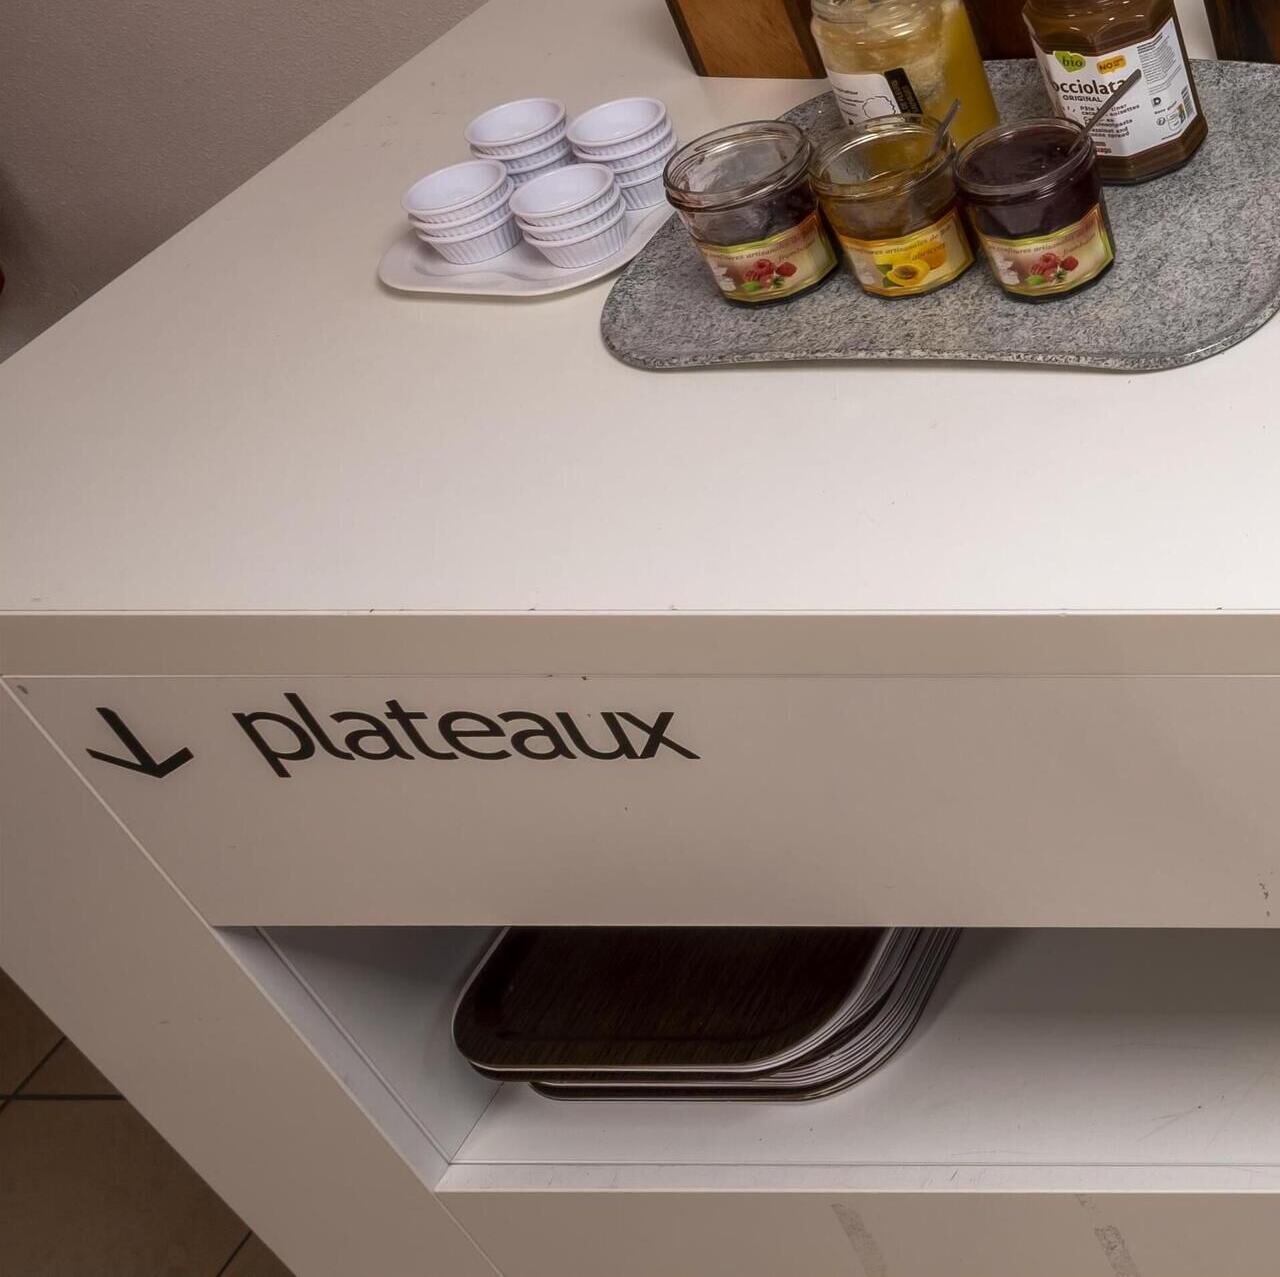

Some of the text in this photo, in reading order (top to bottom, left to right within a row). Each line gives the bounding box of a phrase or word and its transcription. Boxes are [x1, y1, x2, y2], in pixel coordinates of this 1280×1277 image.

[1062, 56, 1083, 67] bio
[1052, 78, 1126, 95] occiolat
[1062, 94, 1103, 103] ORIGINAL
[232, 692, 701, 778] plateaux
